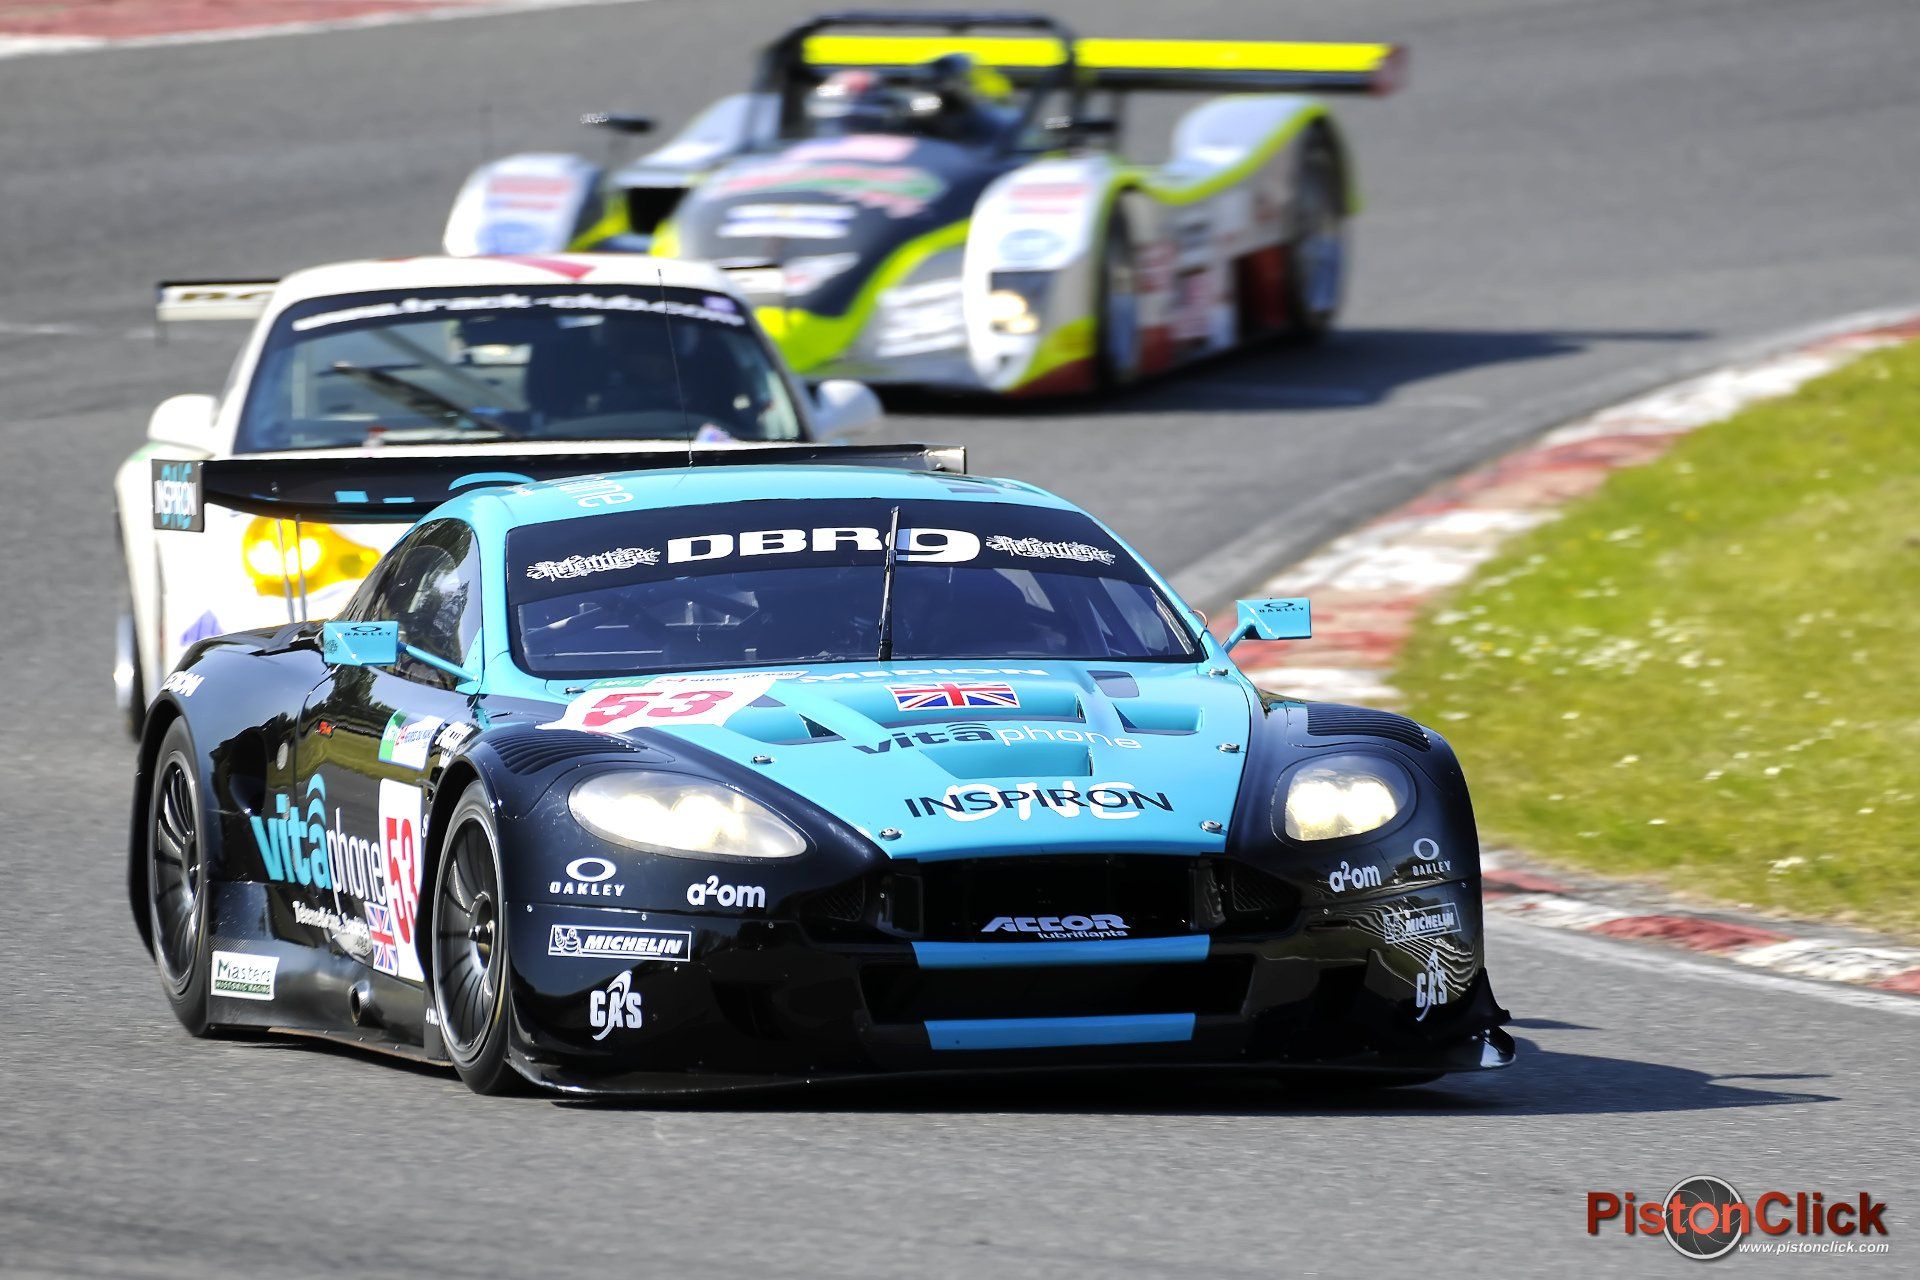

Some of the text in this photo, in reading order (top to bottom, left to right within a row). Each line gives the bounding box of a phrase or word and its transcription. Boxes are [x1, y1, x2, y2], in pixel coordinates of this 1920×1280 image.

[667, 527, 981, 564] DBR9
[582, 690, 733, 727] 53
[853, 722, 1142, 755] vitaphone
[904, 789, 1175, 818] INSPIRON
[251, 788, 387, 916] vitaphone
[386, 817, 419, 944] 53
[1412, 860, 1451, 876] OAKLEY
[549, 880, 625, 897] OAKLEY
[980, 913, 1131, 933] ACCOR
[1037, 929, 1129, 940] lubrifiants
[1405, 911, 1455, 934] MICHELIN
[583, 933, 683, 955] MICHELIN
[217, 958, 271, 983] Masters
